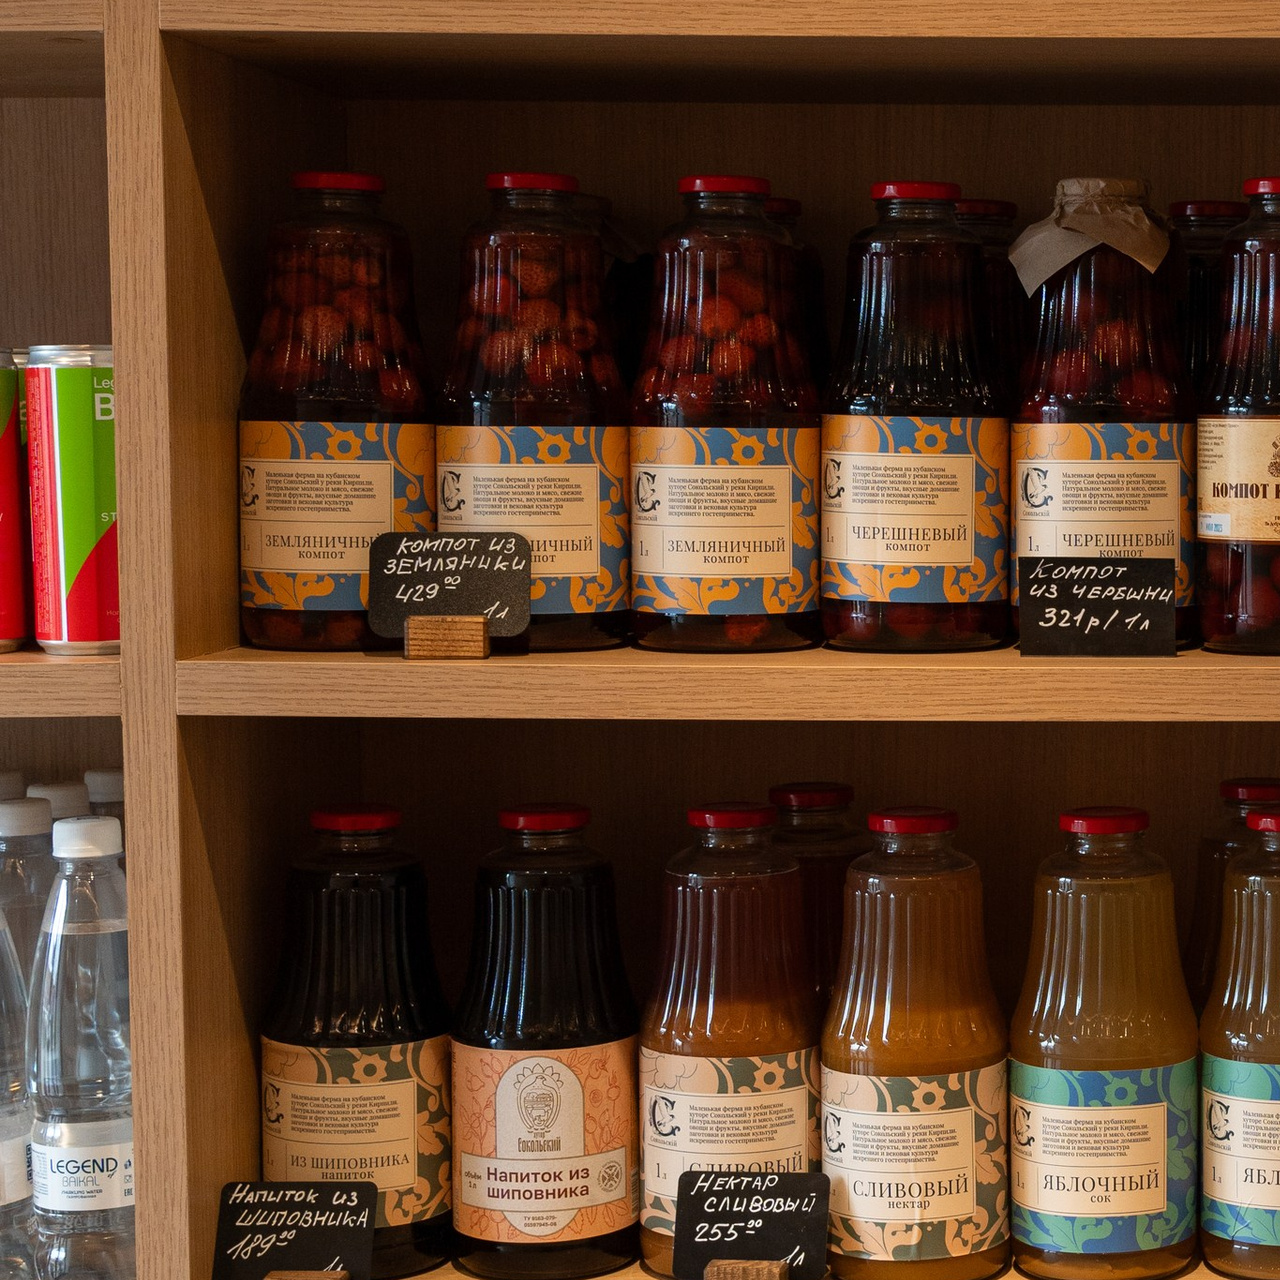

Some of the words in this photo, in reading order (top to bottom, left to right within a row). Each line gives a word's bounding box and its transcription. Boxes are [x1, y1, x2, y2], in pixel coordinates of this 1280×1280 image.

[1212, 482, 1268, 498] КОМПОТ
[852, 524, 968, 541] ЧЕРЕШНЕВЫЙ
[1062, 529, 1175, 547] ЧЕРЕШНЕВЫЙ
[396, 538, 479, 555] КОМПОТ
[667, 537, 786, 552] ЗЕМЛЯНИЧНЫЙ
[885, 542, 931, 552] компот
[298, 549, 346, 559] компот
[703, 554, 749, 564] компот
[1099, 549, 1144, 558] компот
[384, 556, 526, 575] ЗЕМЛЯНИКИ
[1029, 559, 1128, 579] КОМПОТ
[1071, 585, 1173, 602] ЧЕРЕШНИ
[518, 1137, 561, 1152] Сокольский
[50, 1158, 118, 1174] LEGEND
[291, 1154, 307, 1167] ИЗ
[311, 1153, 410, 1169] ШИПОВНИКА
[62, 1176, 100, 1187] BAIKAL
[321, 1169, 375, 1180] напиток
[487, 1167, 562, 1183] Напиток
[569, 1168, 590, 1179] из
[1043, 1169, 1159, 1192] ЯБЛОЧНЫЙ
[691, 1174, 778, 1194] НЕКТАР
[853, 1174, 968, 1198] СЛИВОВЫЙ
[229, 1184, 319, 1205] НАПИТОК
[487, 1185, 589, 1200] шиповника
[1090, 1194, 1111, 1203] сок
[704, 1194, 816, 1213] СЛИВОВЫЙ
[888, 1198, 930, 1210] нектар
[235, 1208, 367, 1228] ШИПОВНИКА
